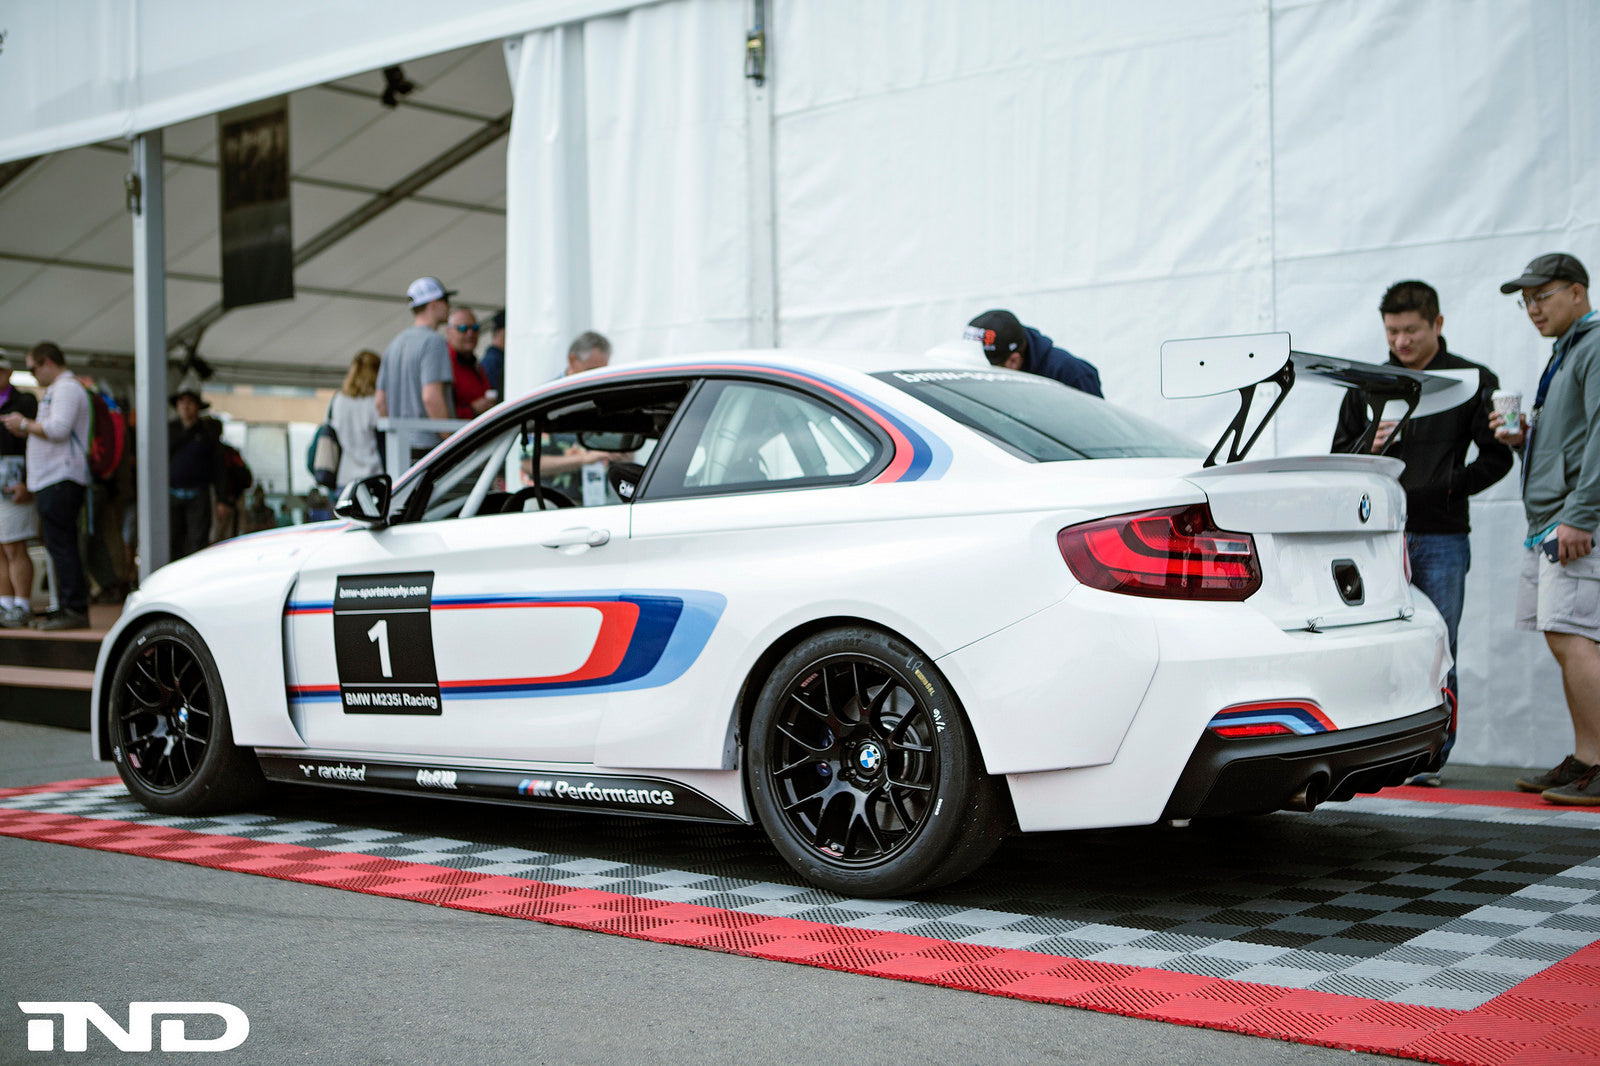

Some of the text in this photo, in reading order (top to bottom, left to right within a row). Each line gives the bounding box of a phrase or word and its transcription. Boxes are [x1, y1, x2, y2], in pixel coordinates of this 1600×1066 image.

[339, 585, 428, 599] bmw-sportstrophy.com
[367, 619, 393, 678] 1
[344, 692, 438, 710] BMW M235i Racing
[317, 762, 366, 781] randstad
[554, 780, 675, 805] Performance
